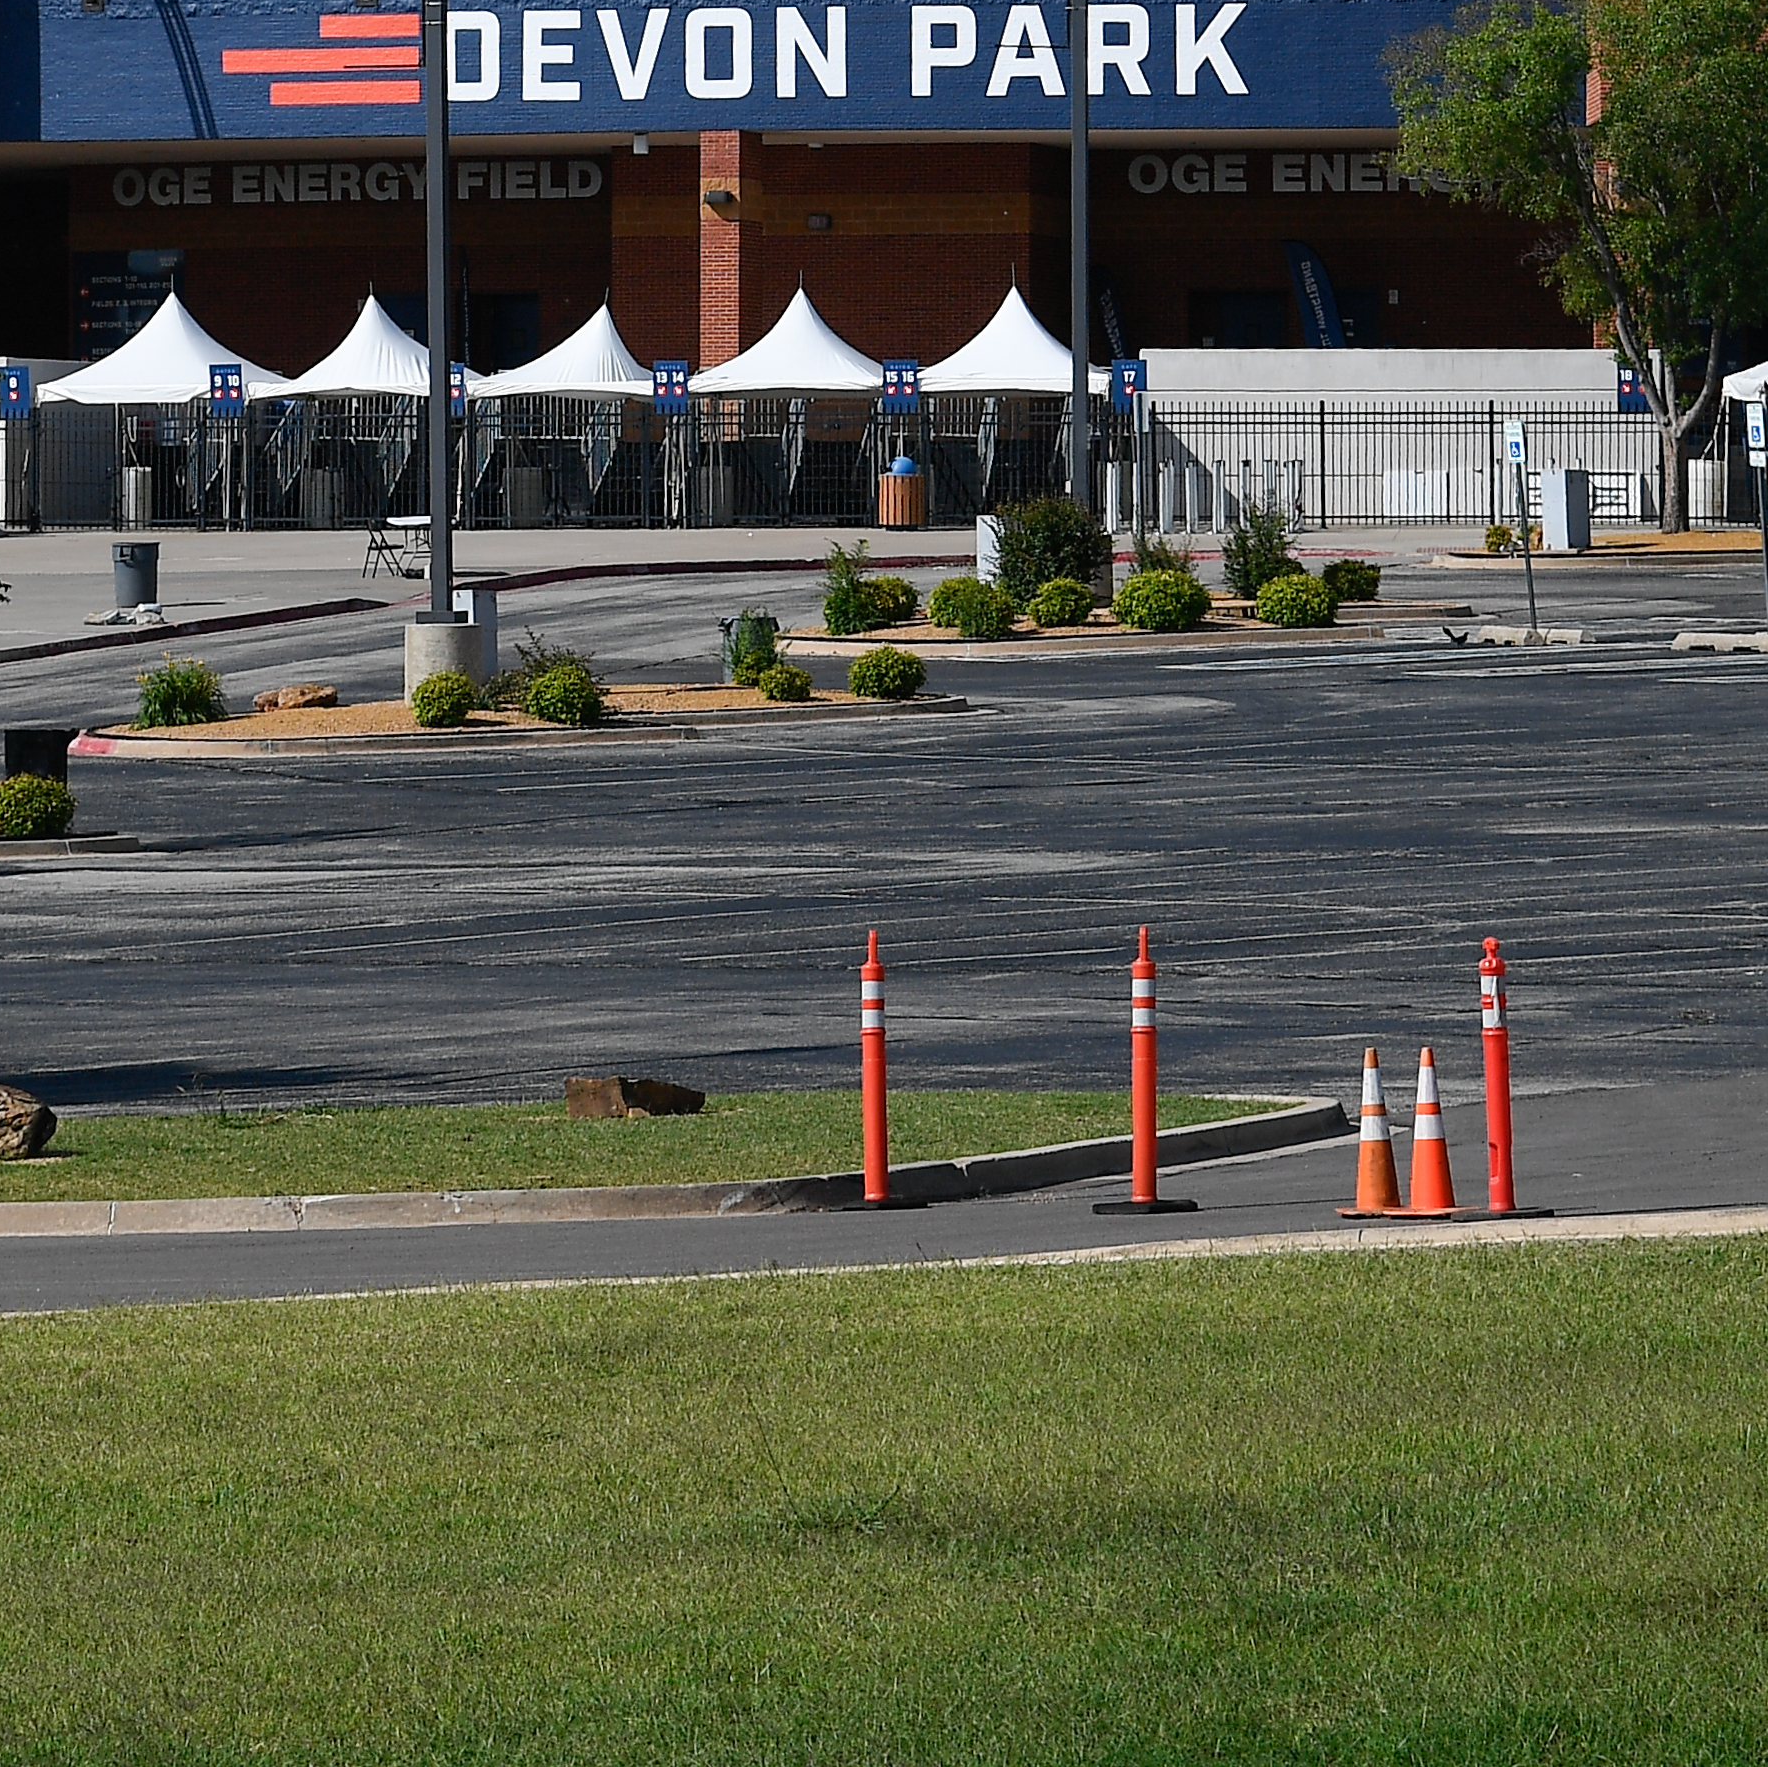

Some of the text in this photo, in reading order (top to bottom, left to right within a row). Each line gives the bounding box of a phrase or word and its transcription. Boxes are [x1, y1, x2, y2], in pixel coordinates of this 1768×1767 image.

[445, 1, 1250, 102] DEVON PARK
[1128, 153, 1247, 194] OGE
[112, 158, 604, 206] OGE ENERGY FIELD
[91, 276, 122, 284] SECTIONS
[213, 374, 241, 387] 9 10
[450, 373, 462, 386] 12
[655, 371, 685, 384] 13 14
[885, 371, 915, 383] 15 16
[1123, 370, 1137, 383] 17
[1619, 369, 1633, 382] 18
[8, 376, 18, 389] 8
